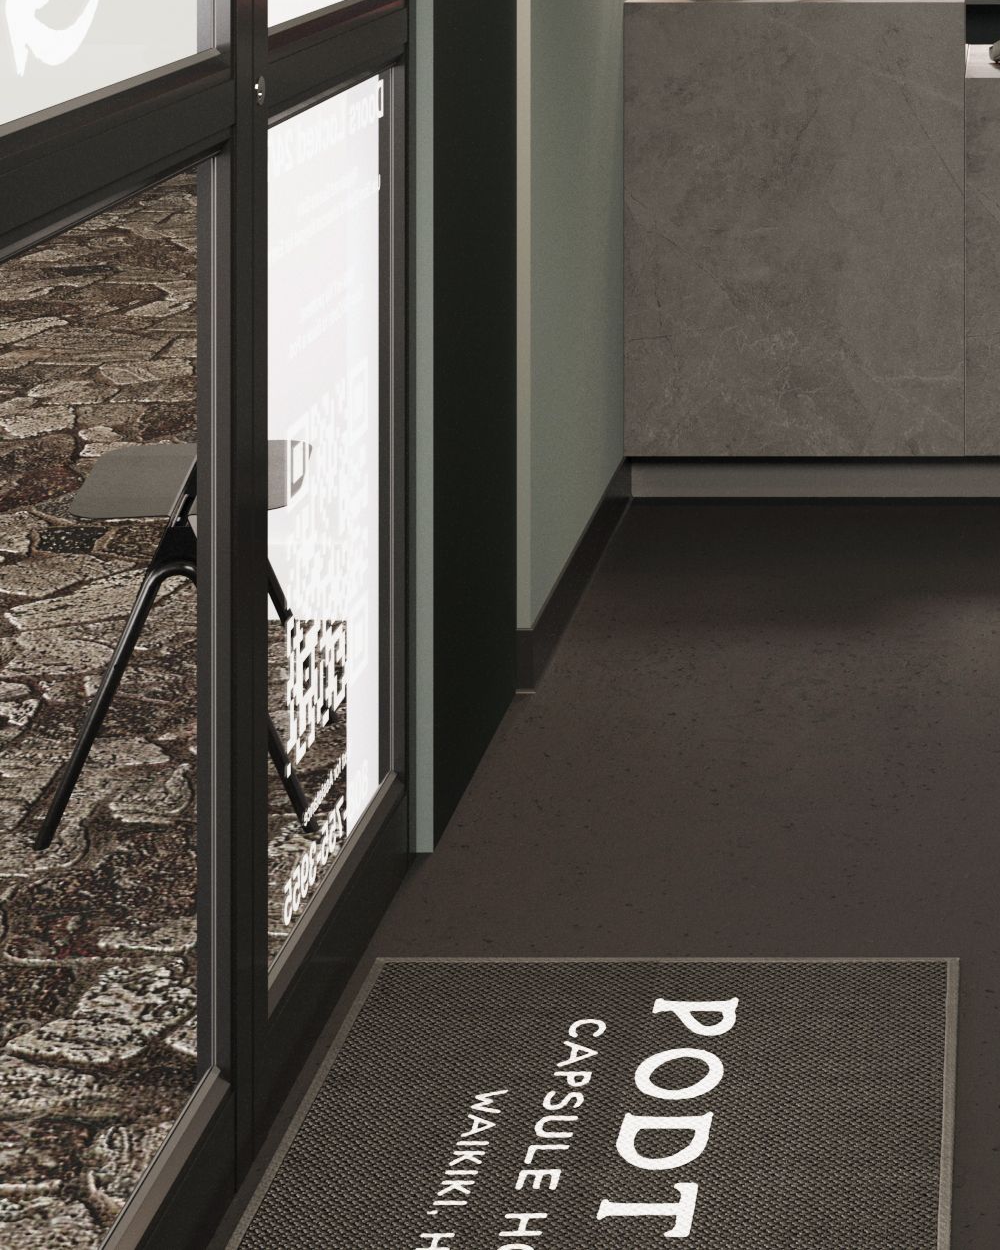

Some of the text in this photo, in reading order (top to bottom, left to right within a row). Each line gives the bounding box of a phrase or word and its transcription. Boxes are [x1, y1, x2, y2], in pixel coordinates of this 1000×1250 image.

[426, 1089, 510, 1216] WAIKIKI,
[497, 1018, 608, 1250] CAPSULE H
